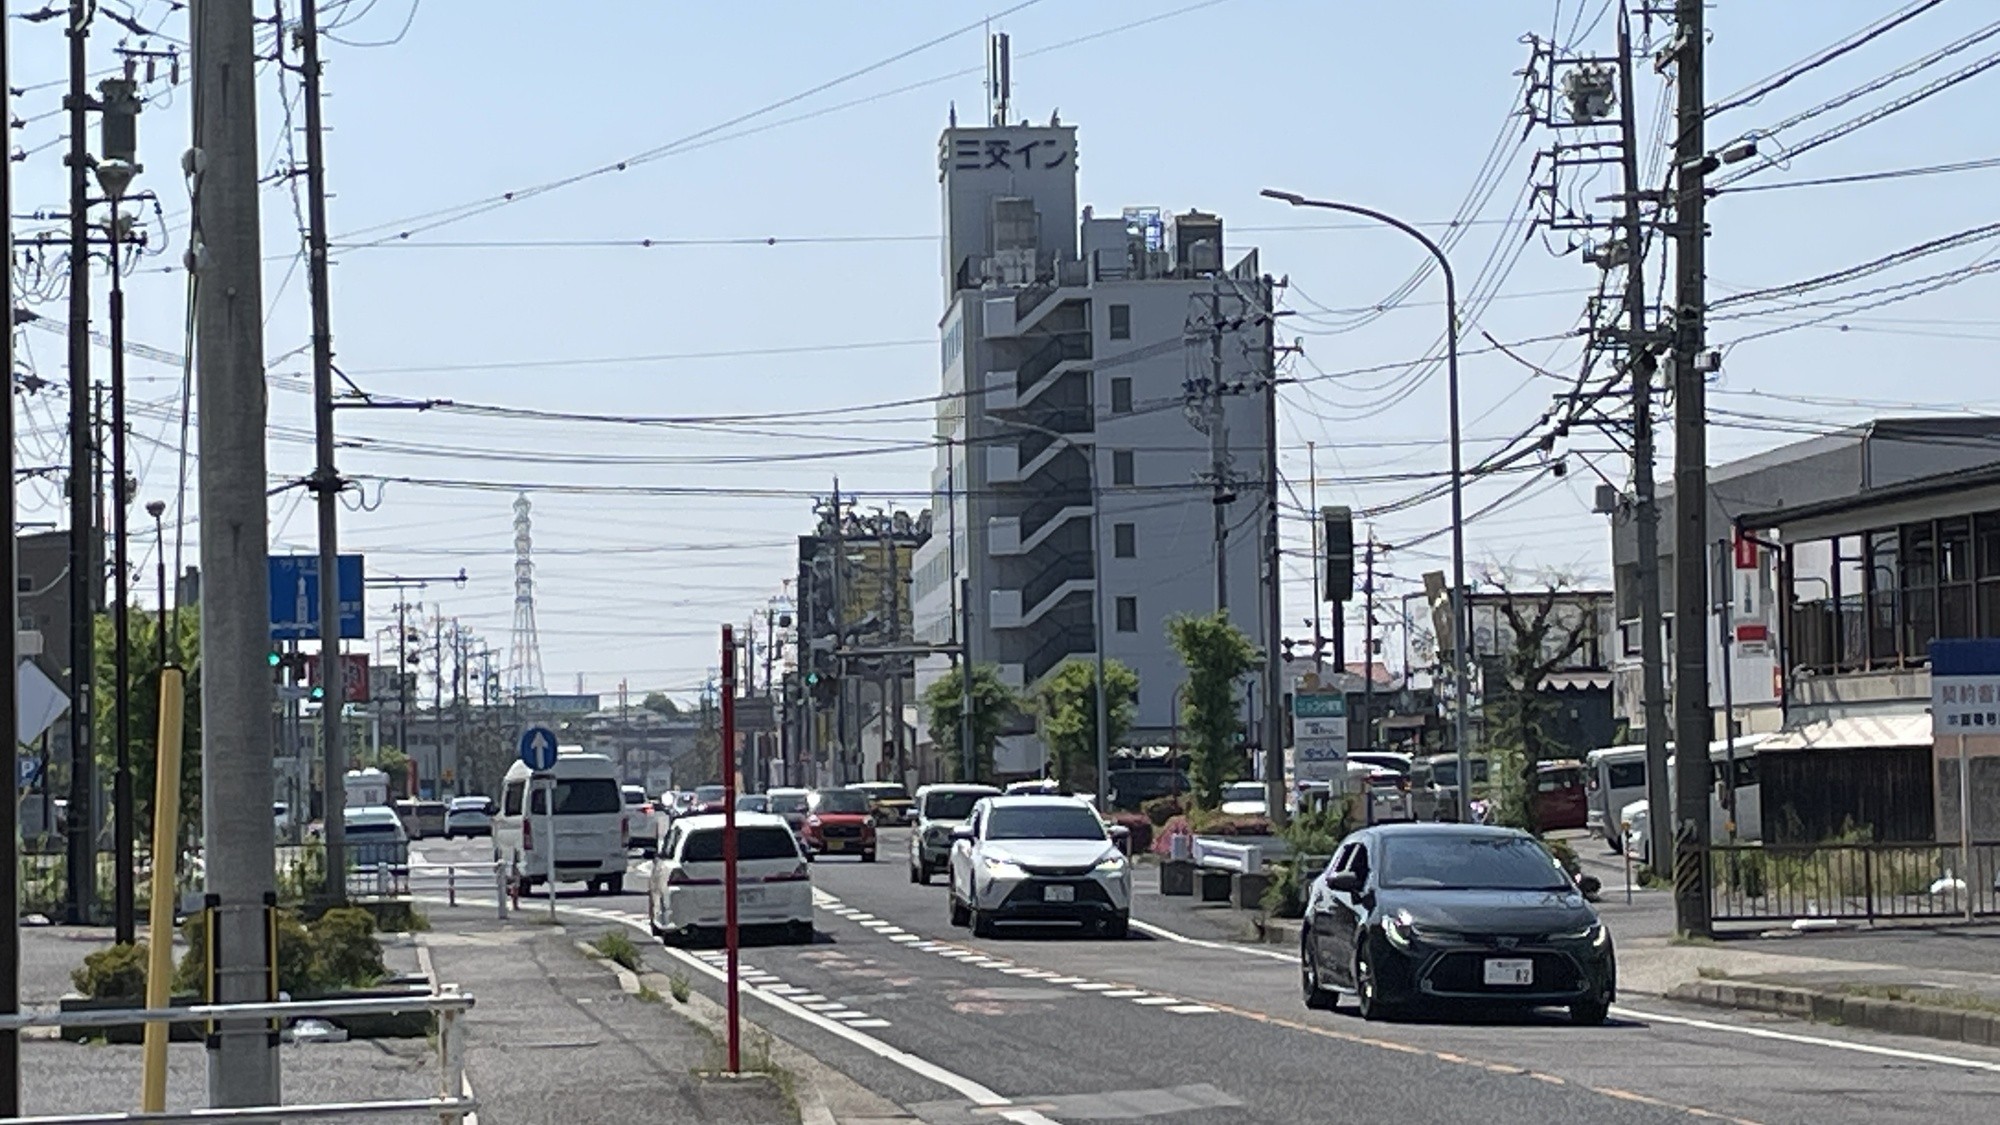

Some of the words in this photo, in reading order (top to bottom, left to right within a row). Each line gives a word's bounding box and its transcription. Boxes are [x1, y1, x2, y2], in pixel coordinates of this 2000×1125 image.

[955, 139, 1068, 171] 三交イン
[21, 760, 35, 778] P
